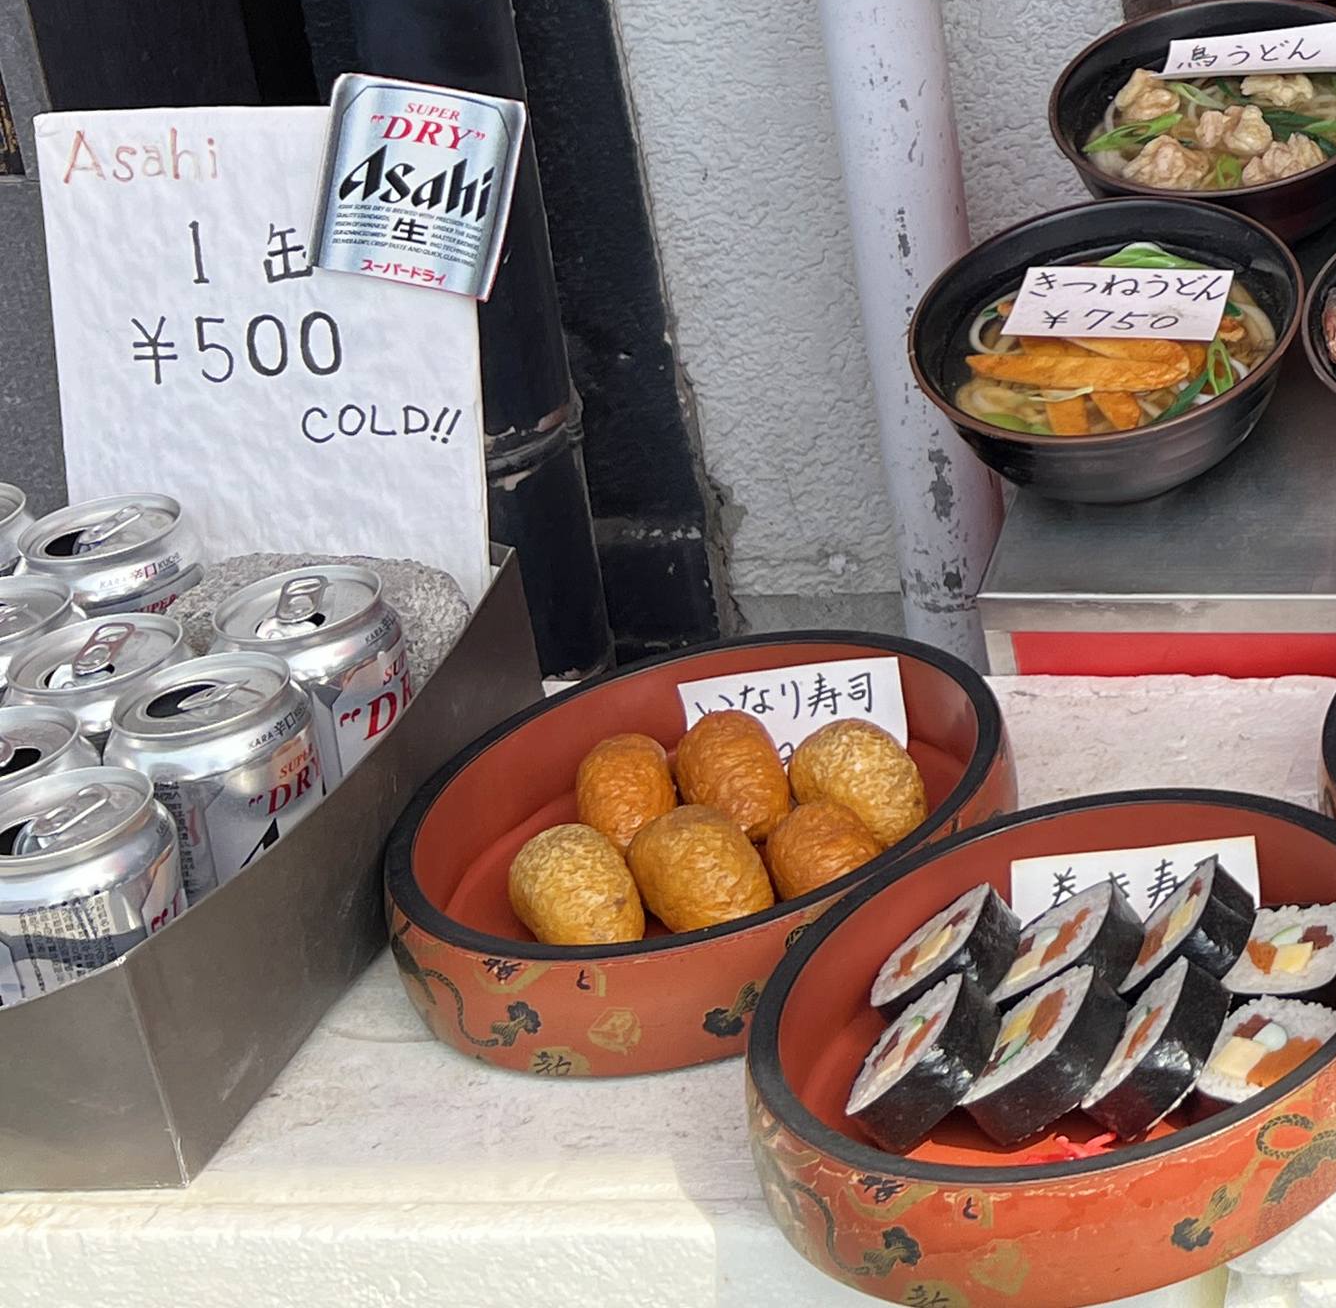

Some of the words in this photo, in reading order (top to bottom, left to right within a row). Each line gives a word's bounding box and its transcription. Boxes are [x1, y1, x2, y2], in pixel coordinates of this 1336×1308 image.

[405, 102, 460, 121] SUPER
[63, 127, 219, 183] Asahi
[338, 144, 495, 223] Asahi
[392, 216, 429, 245] 生
[188, 220, 210, 284] 1
[361, 259, 447, 285] スーパードライ
[1029, 271, 1224, 301] きつねうどん
[1042, 308, 1179, 330] ¥750
[131, 310, 342, 385] ¥500
[301, 403, 462, 444] COLD!!
[695, 672, 872, 719] いなり寿司
